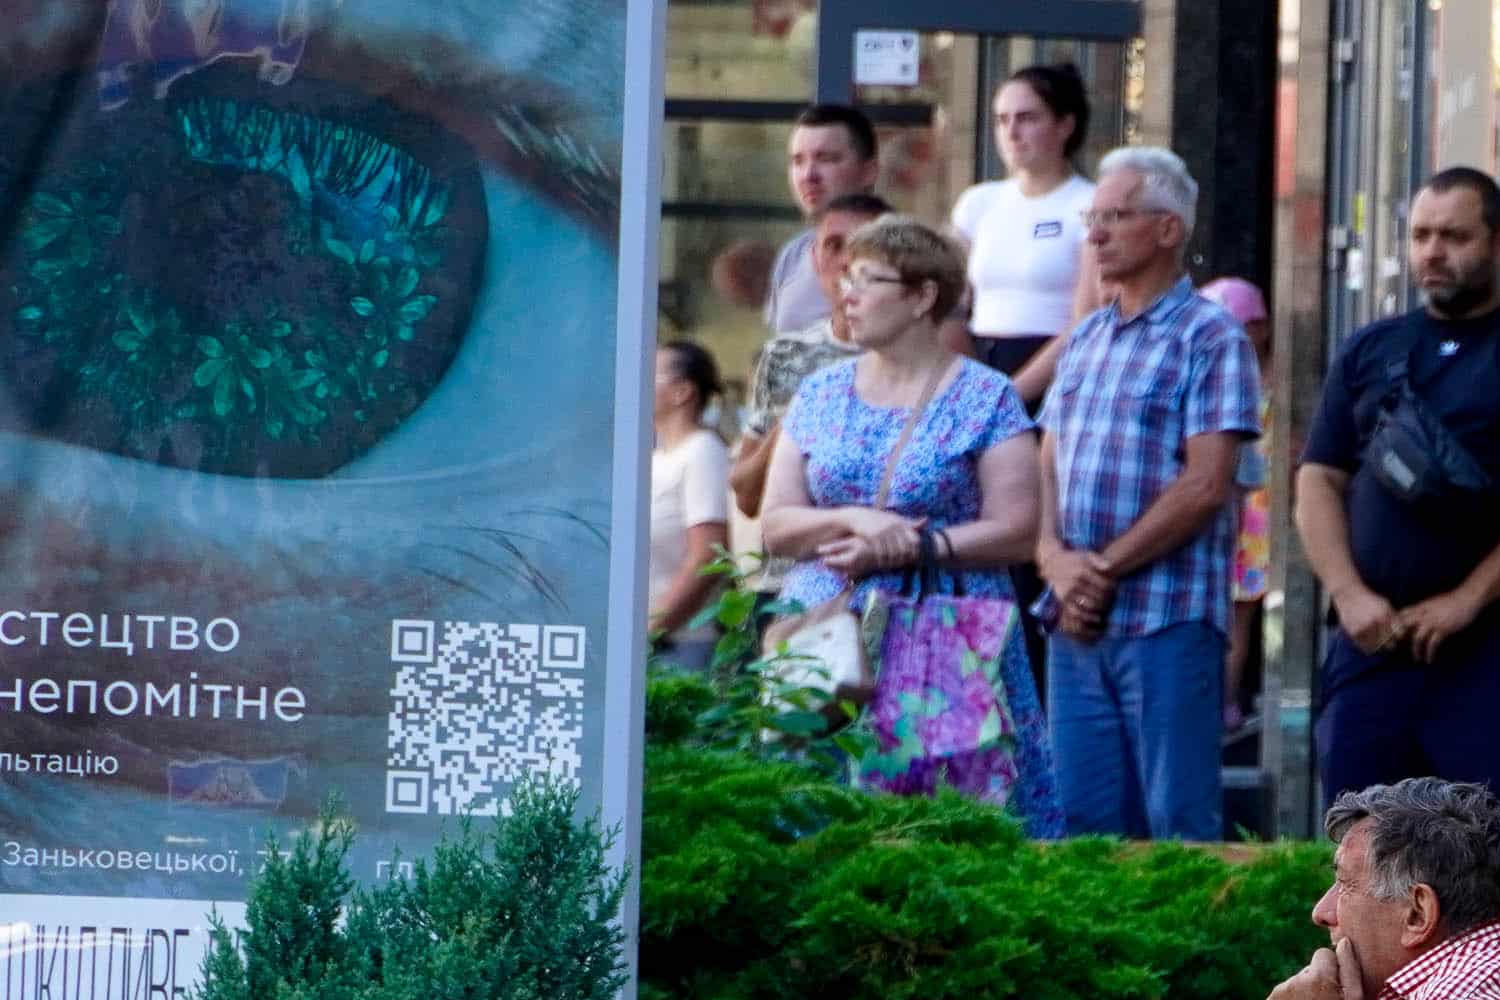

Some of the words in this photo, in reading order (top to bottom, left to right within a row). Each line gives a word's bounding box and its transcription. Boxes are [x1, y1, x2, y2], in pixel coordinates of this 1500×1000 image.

[0, 610, 240, 656] стецтво
[0, 672, 306, 722] непомітне
[3, 841, 244, 876] Заньковецької,
